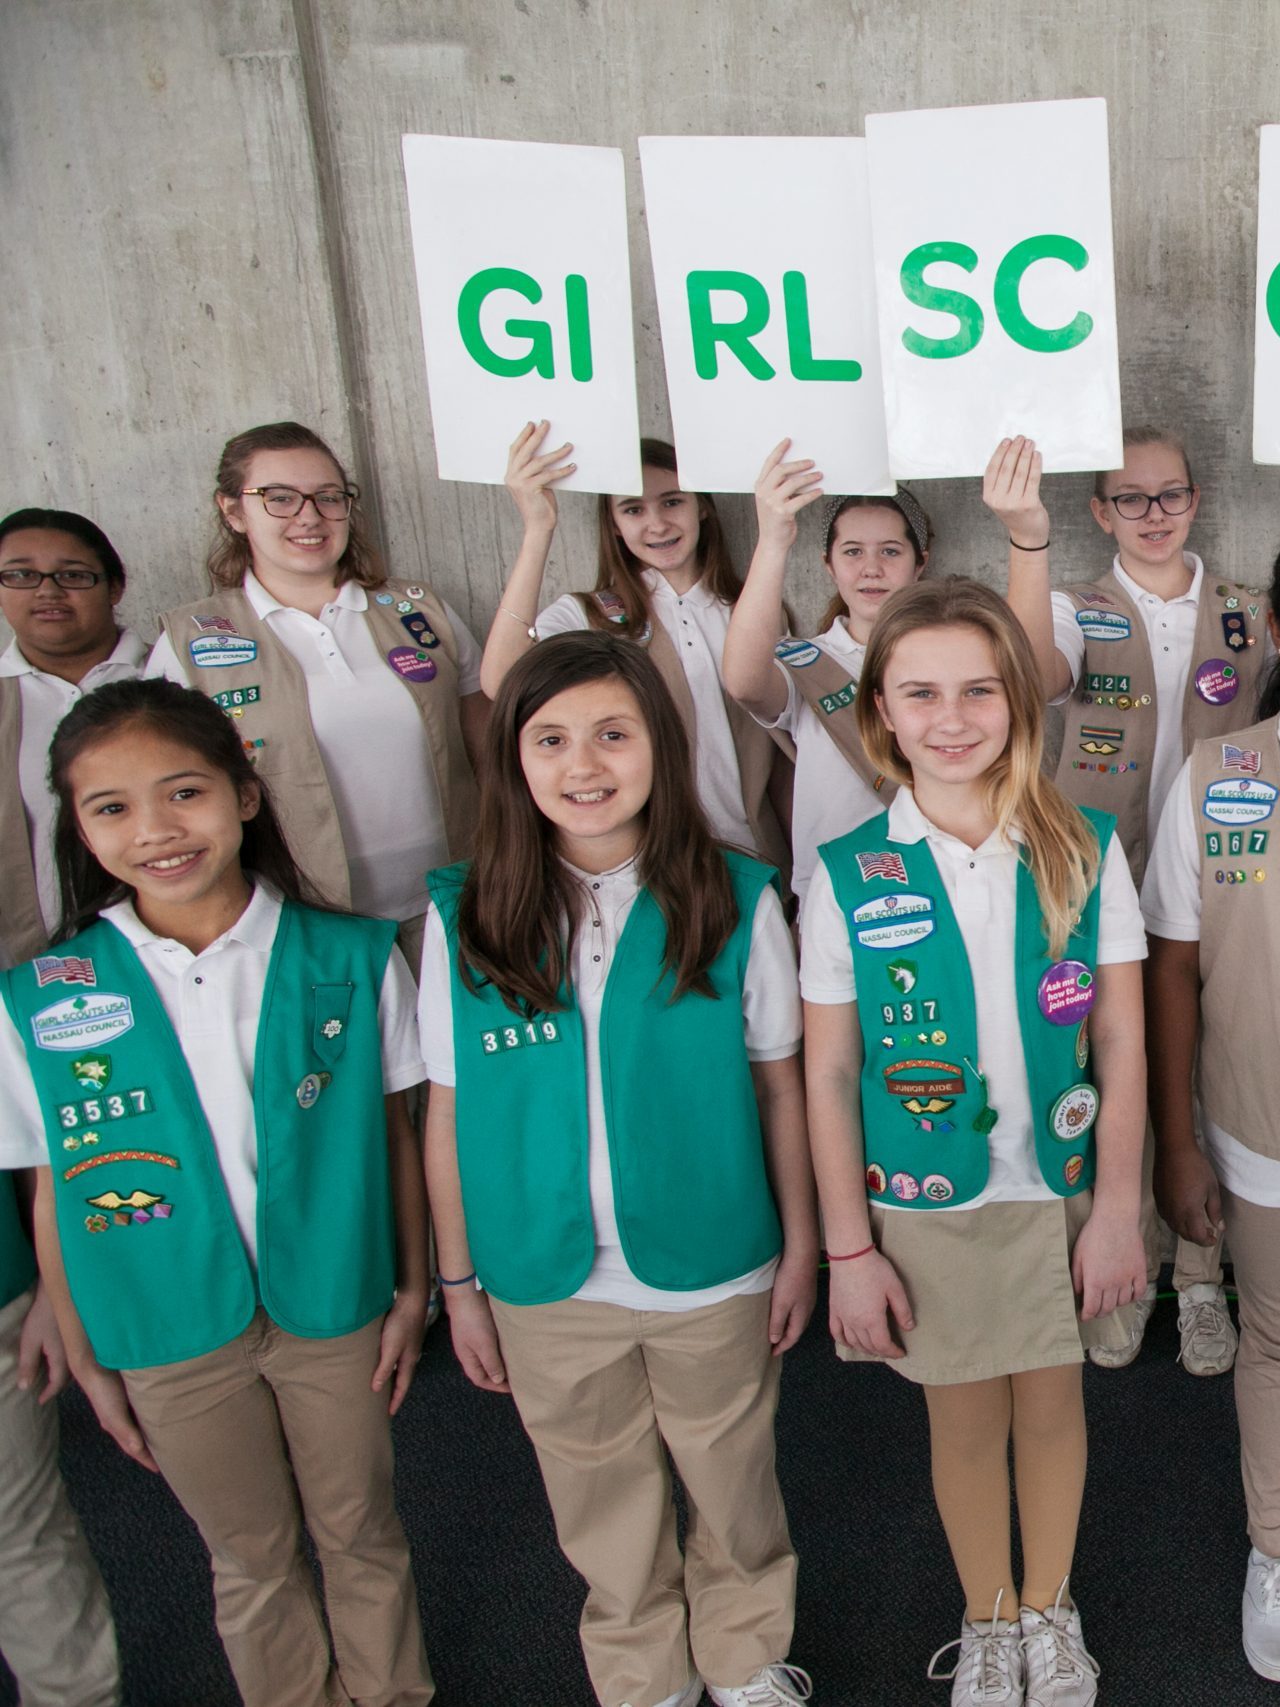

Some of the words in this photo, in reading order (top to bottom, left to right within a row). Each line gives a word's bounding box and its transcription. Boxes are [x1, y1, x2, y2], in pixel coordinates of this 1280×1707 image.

[900, 234, 1093, 359] SC
[458, 267, 593, 382] GI
[686, 270, 862, 382] RL
[1210, 833, 1264, 852] 967
[856, 912, 873, 922] GIRL
[875, 906, 908, 918] SCOUTS
[910, 904, 928, 912] USA
[861, 932, 891, 943] NASSAU
[895, 926, 928, 937] COUNCIL
[1046, 981, 1061, 992] Ask
[1062, 978, 1075, 987] me
[1048, 991, 1065, 1001] how
[883, 1001, 935, 1023] 937
[1049, 1000, 1065, 1013] join
[1066, 989, 1092, 1005] today!
[37, 1016, 59, 1026] GIRL
[63, 1008, 104, 1021] SCOUTS
[105, 1002, 126, 1011] USA
[43, 1029, 83, 1041] NASSAU
[85, 1019, 126, 1033] COUNCIL
[484, 1022, 556, 1051] 3319
[894, 1084, 924, 1093] JUNIOR
[929, 1084, 952, 1092] AIDE
[61, 1090, 145, 1127] 3537
